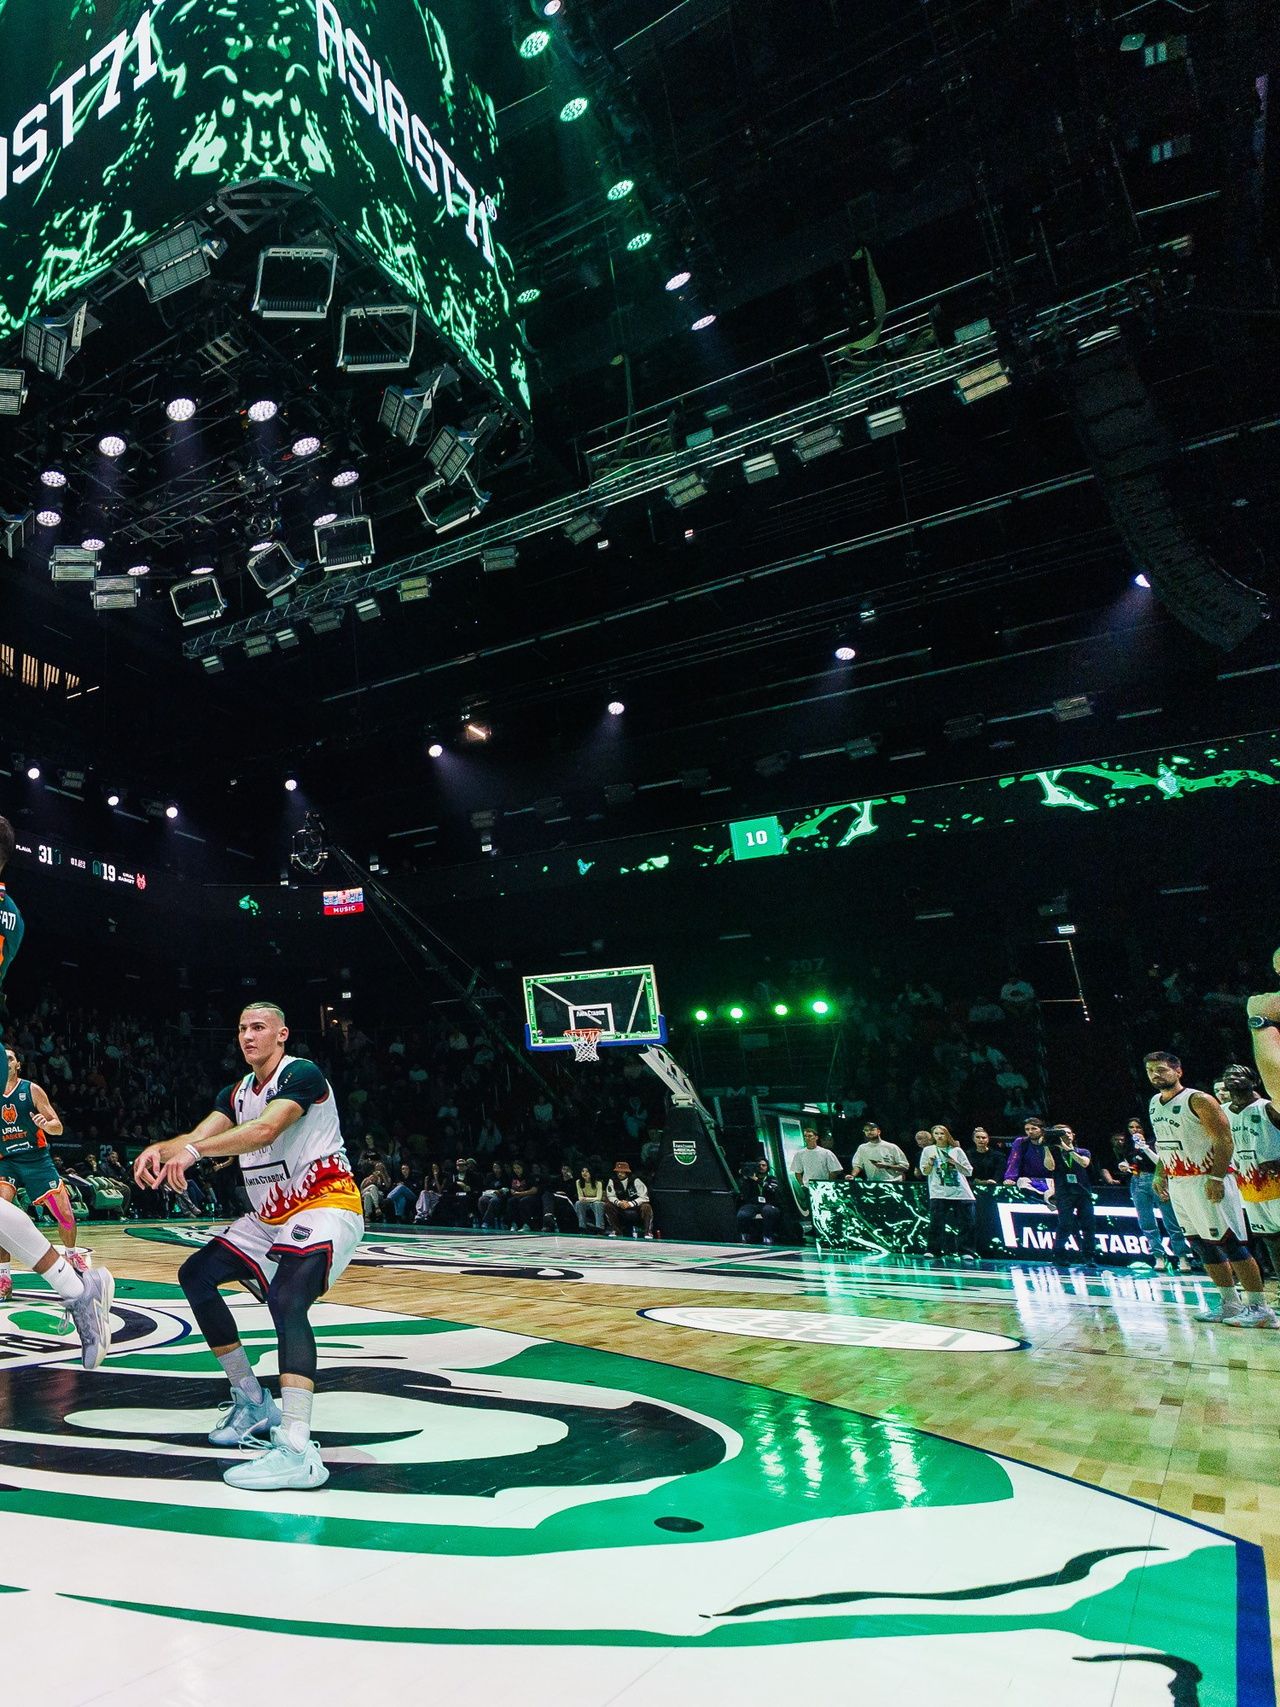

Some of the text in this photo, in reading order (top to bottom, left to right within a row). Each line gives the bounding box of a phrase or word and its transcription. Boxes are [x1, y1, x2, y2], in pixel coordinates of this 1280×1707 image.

[745, 829, 768, 847] 10
[38, 844, 53, 865] 31
[102, 863, 116, 882] 19
[333, 905, 356, 913] MUSIC
[2, 1126, 23, 1135] URAL
[2, 1131, 28, 1142] BASKET
[258, 1173, 286, 1185] СТАВОК
[1022, 1226, 1080, 1251] ЛИА
